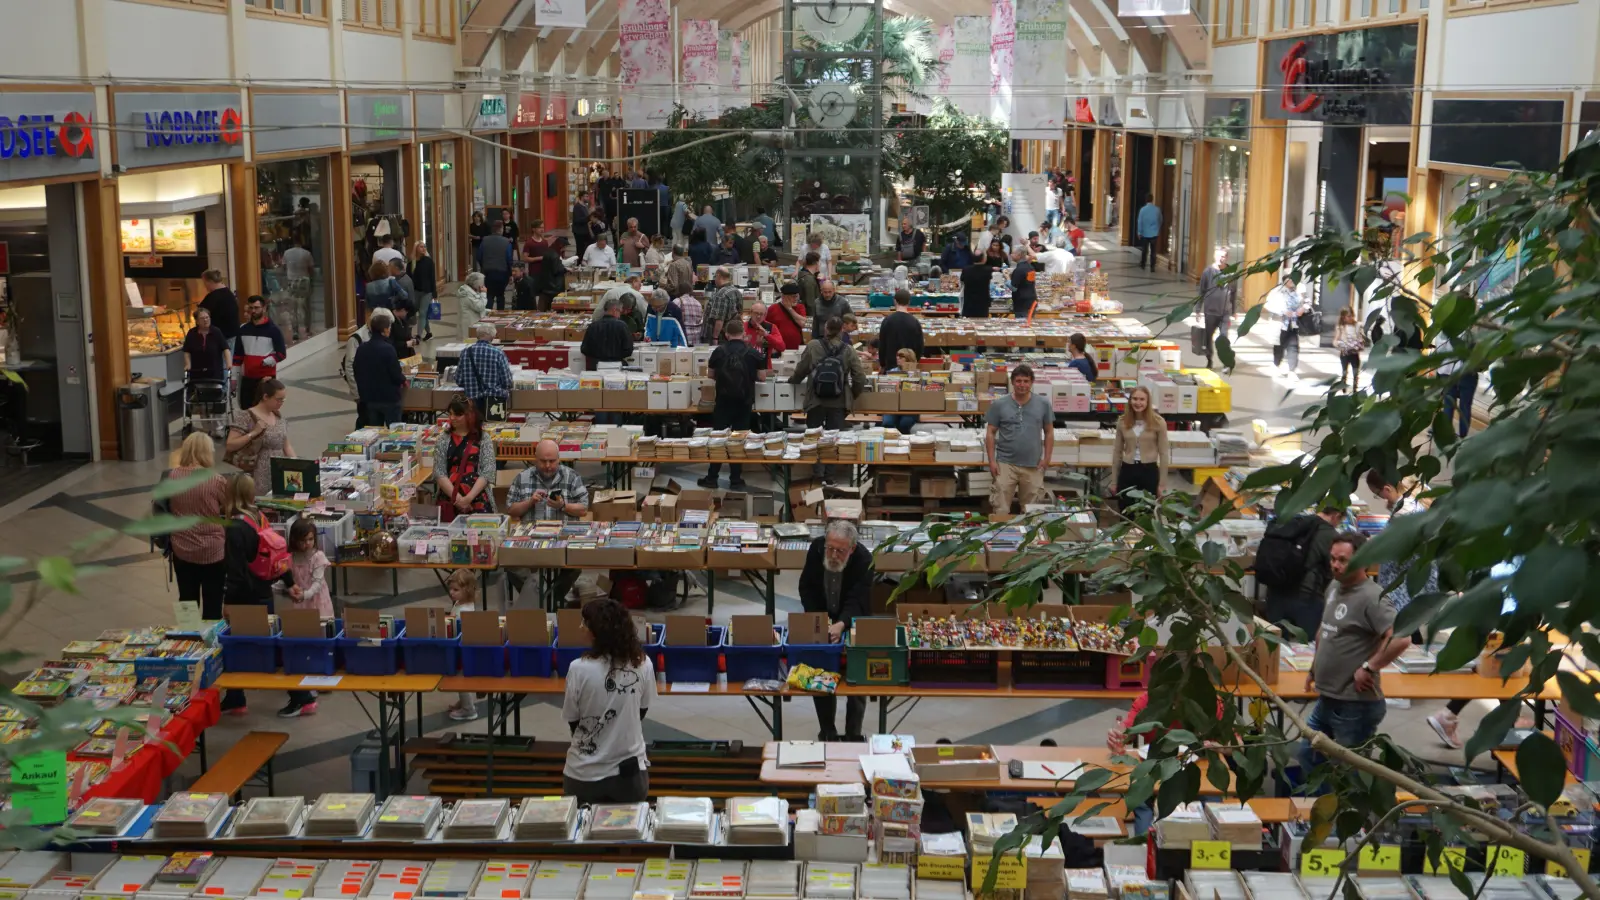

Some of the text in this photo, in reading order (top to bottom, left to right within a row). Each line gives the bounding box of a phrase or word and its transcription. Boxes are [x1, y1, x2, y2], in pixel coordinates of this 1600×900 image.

[622, 23, 667, 33] Frühlings-
[1019, 22, 1065, 31] Frühlings-
[145, 110, 219, 147] NORDSEE
[21, 770, 58, 780] Ankauf
[1196, 849, 1228, 861] 3,- €
[1494, 849, 1518, 862] 0,-
[1308, 854, 1340, 875] 5,-
